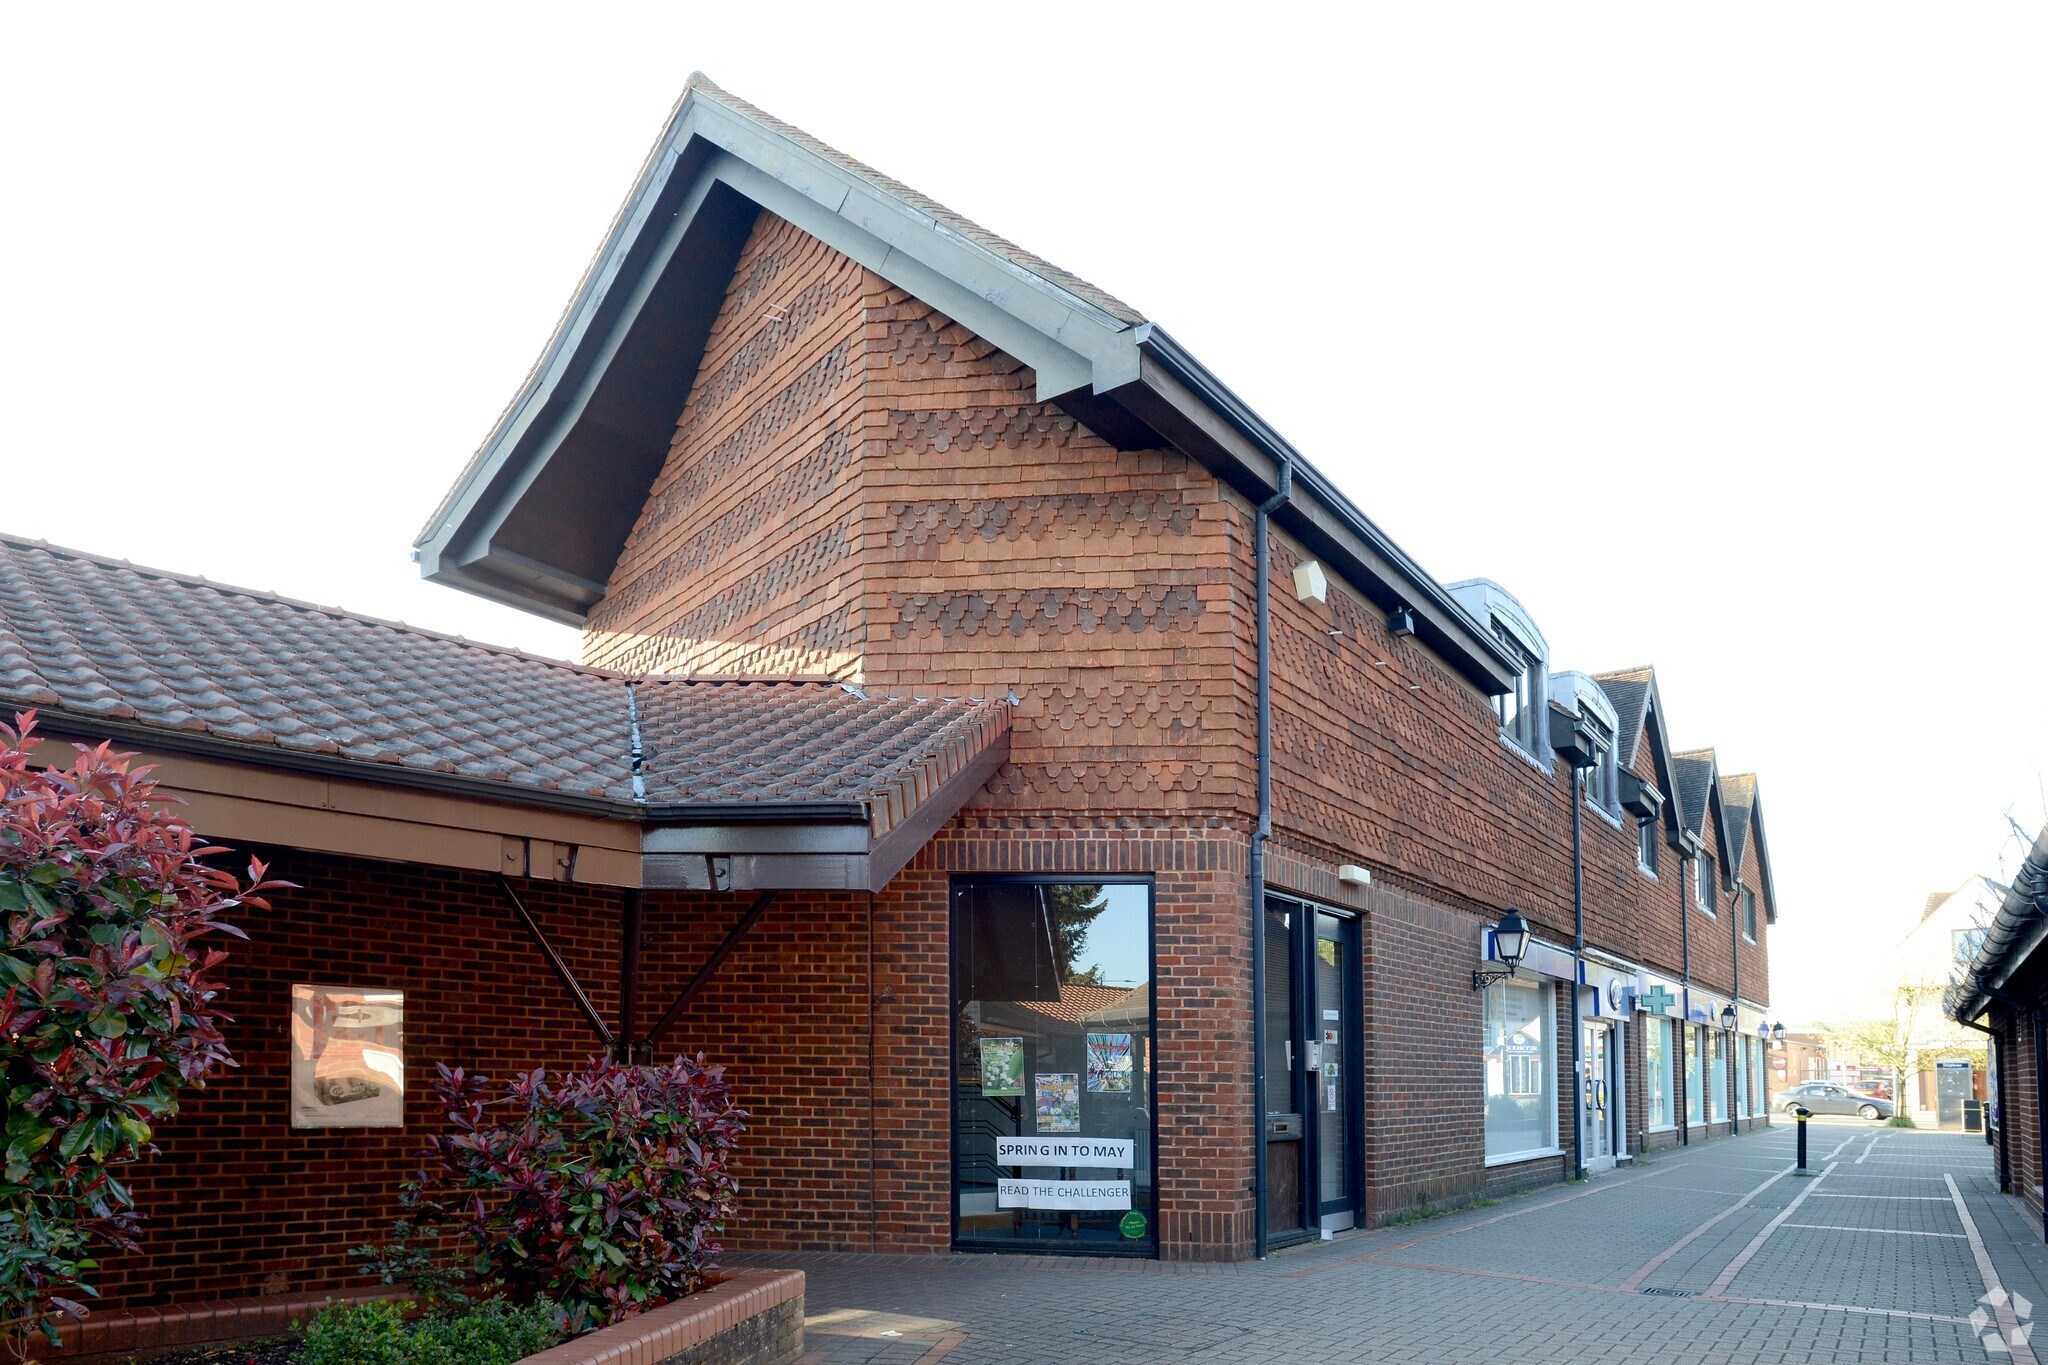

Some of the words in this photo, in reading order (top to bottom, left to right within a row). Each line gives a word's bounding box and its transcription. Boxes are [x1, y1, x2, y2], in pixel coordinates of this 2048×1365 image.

[998, 1144, 1050, 1156] SPRING
[1054, 1145, 1068, 1156] IN
[1071, 1145, 1090, 1157] TO
[1093, 1146, 1125, 1158] MAY
[1000, 1185, 1029, 1196] READ
[1032, 1186, 1054, 1197] THE
[1057, 1187, 1129, 1198] CHALLENGER
